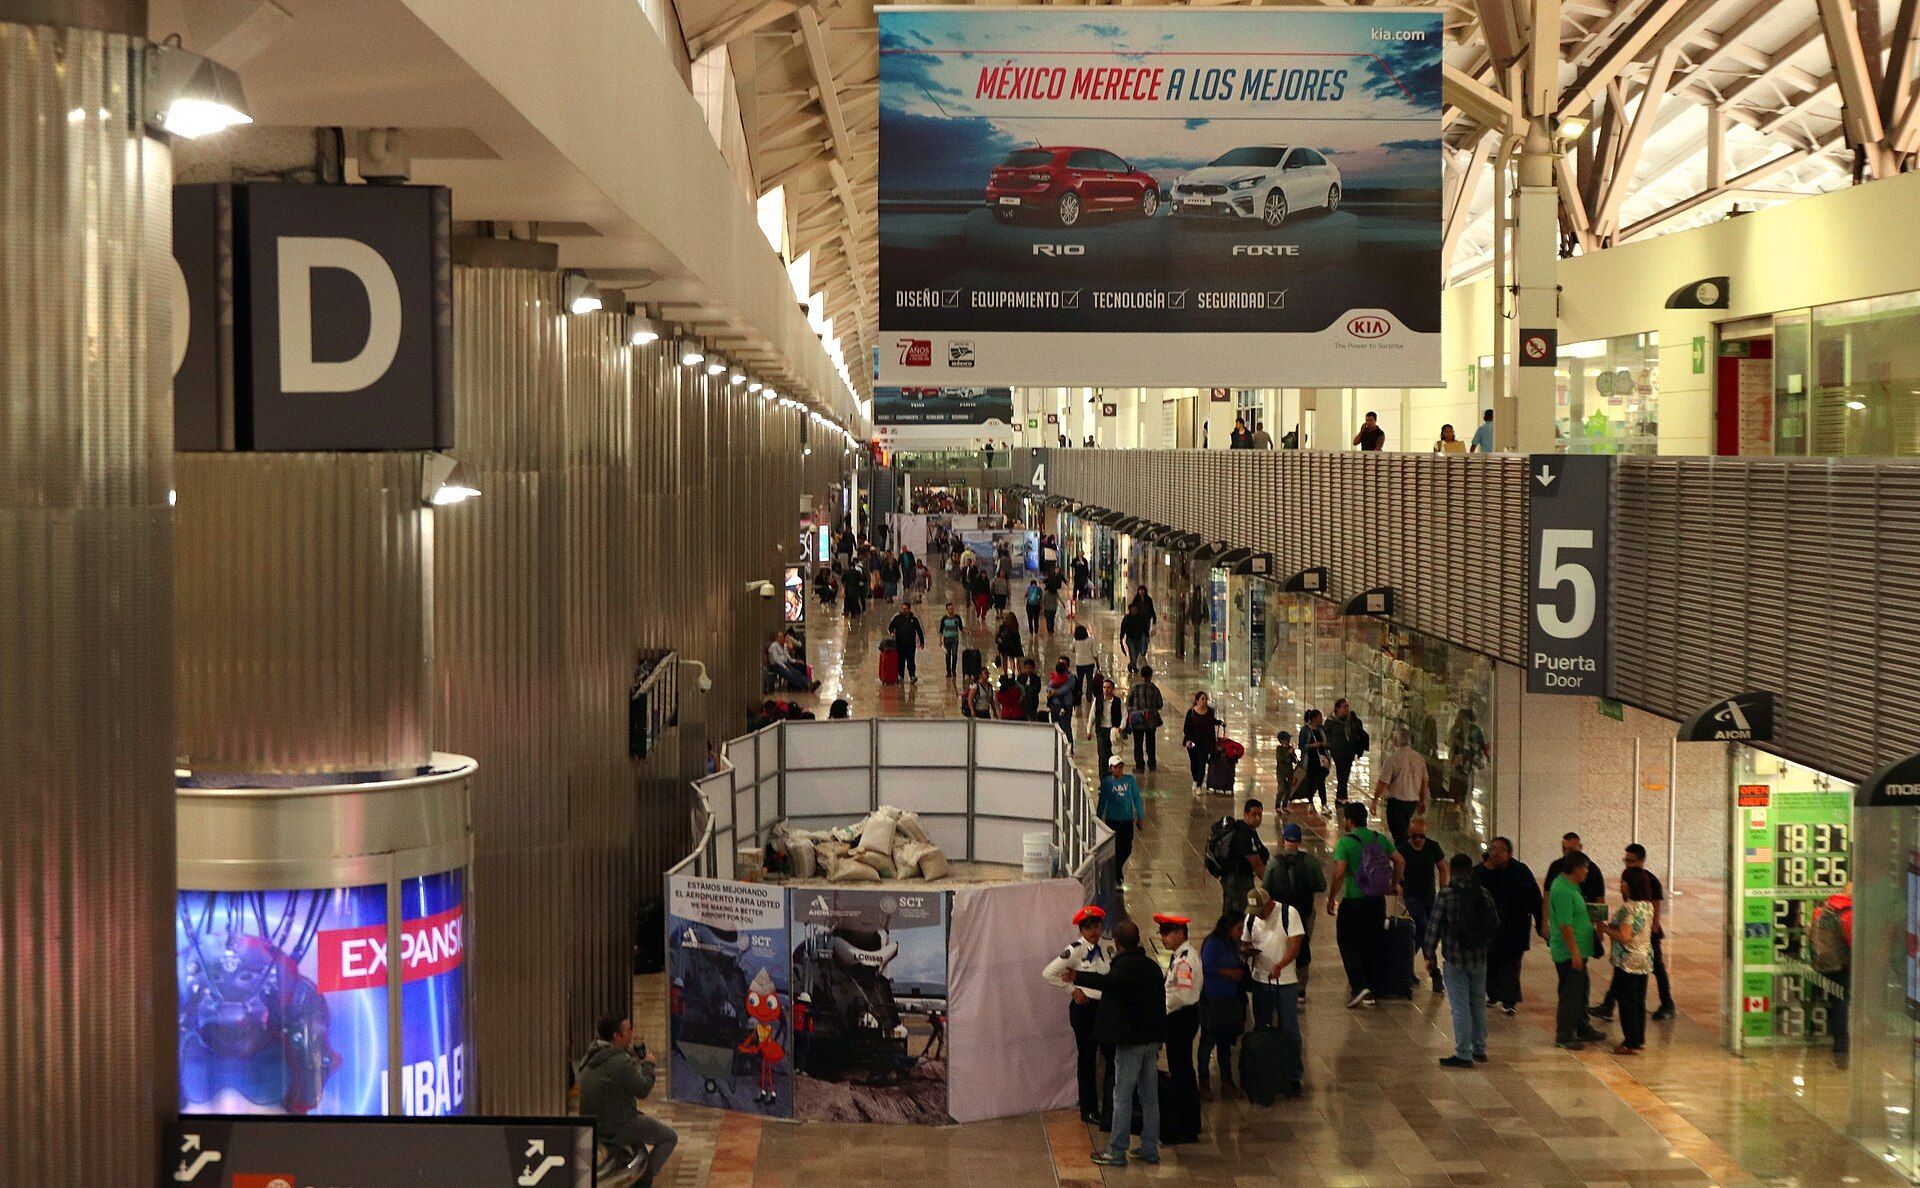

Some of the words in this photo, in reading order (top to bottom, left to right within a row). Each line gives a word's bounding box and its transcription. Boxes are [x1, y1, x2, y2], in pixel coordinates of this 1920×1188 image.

[1371, 27, 1426, 41] kia.com
[975, 60, 1067, 100] MÉXICO
[1070, 67, 1165, 101] MERECE
[1166, 68, 1186, 101] A
[1189, 69, 1236, 101] LOS
[1240, 69, 1348, 101] MEJORES
[1032, 244, 1085, 257] RIO
[1232, 245, 1300, 256] FORTE
[896, 288, 940, 308] DISEÑO
[971, 291, 1060, 308] EQUIPAMIENTO
[1093, 289, 1165, 309] TECNOLOGÍA
[1198, 292, 1265, 309] SEGURIDAD
[277, 236, 402, 393] D
[1354, 321, 1384, 334] KIA
[897, 338, 915, 366] 7
[1031, 463, 1046, 491] 4
[1536, 529, 1597, 640] 5
[1534, 653, 1597, 672] Puerta
[1545, 673, 1584, 688] Door
[1784, 857, 1847, 887] 18.26
[687, 881, 721, 892] ESTAMOS
[722, 884, 767, 897] MEJORANDO
[685, 891, 733, 904] AEROPUERTO
[735, 897, 755, 906] PARA
[756, 899, 781, 909] USTED
[899, 897, 923, 907] SCT
[751, 935, 772, 947] SCT
